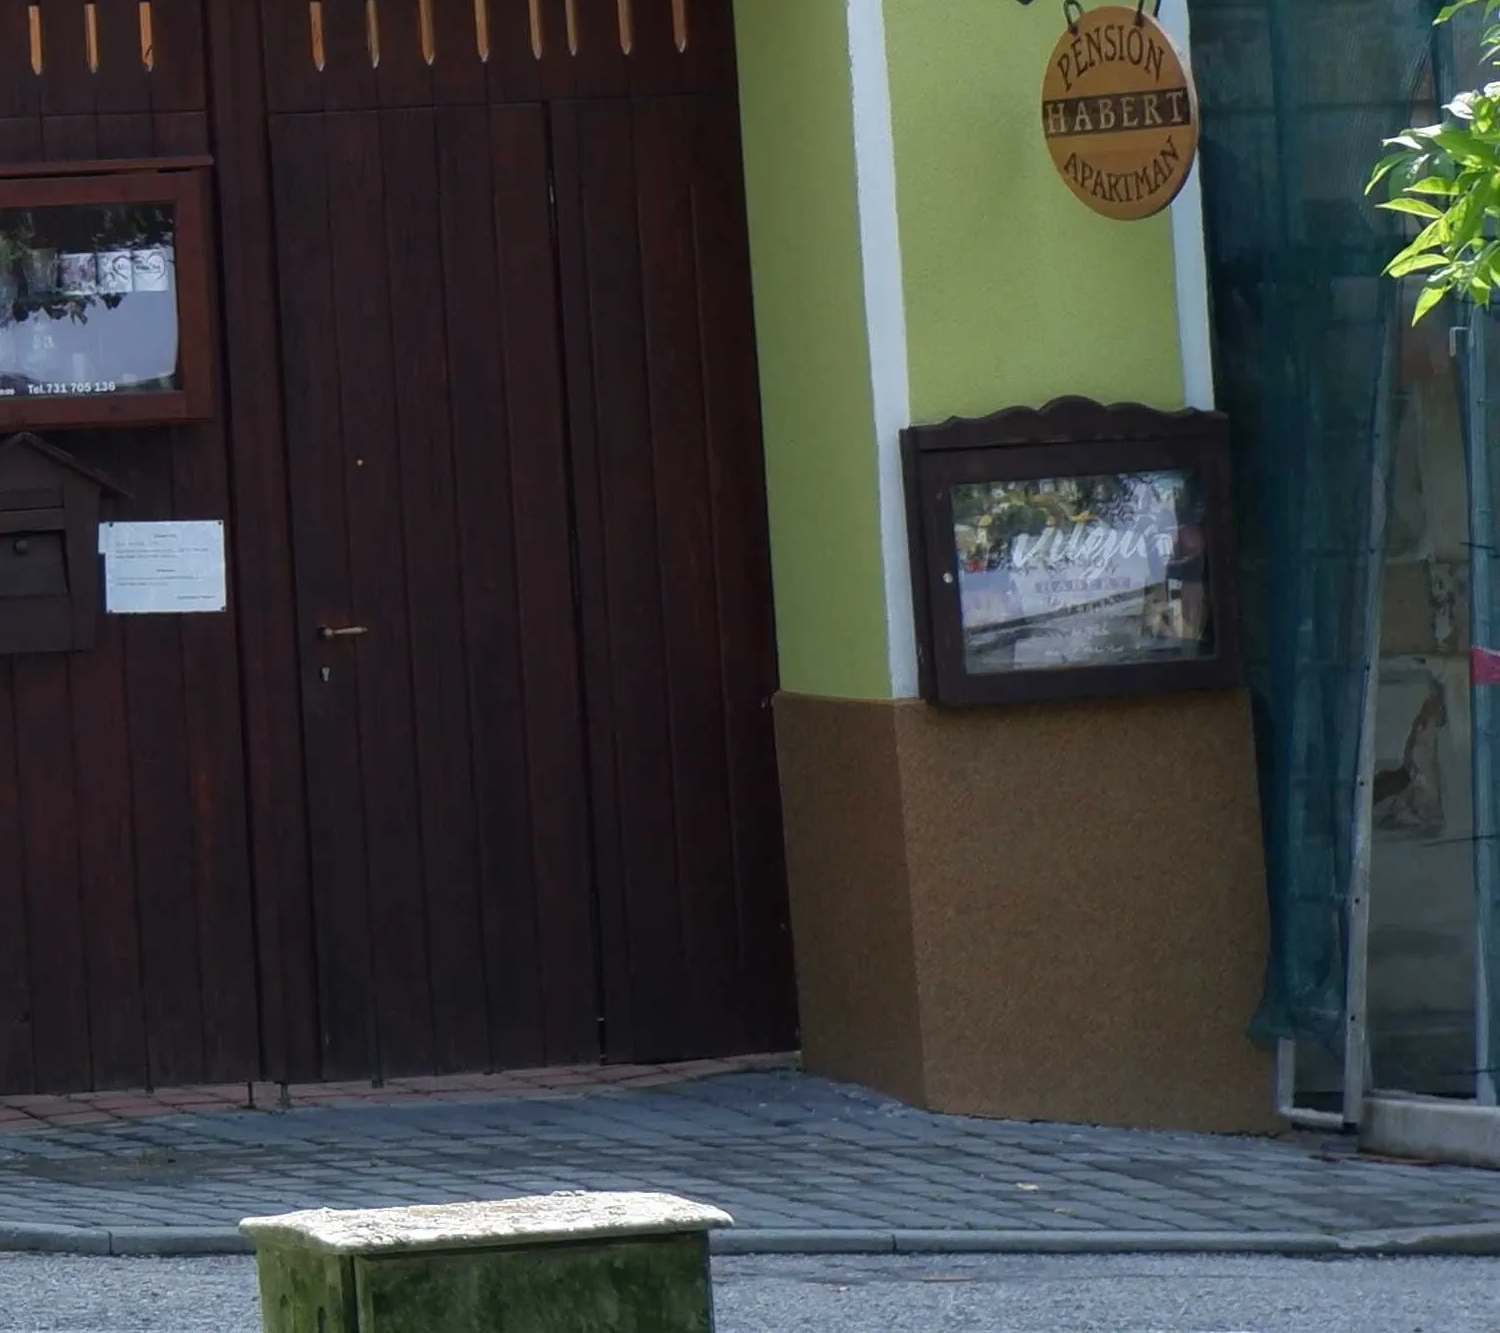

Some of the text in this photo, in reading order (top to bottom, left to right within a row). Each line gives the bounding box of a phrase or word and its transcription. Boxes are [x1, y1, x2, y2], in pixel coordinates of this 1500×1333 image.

[1056, 23, 1165, 93] PENSION
[1045, 90, 1184, 134] HABERT
[1063, 134, 1181, 203] APARTMAN
[70, 381, 92, 393] 705
